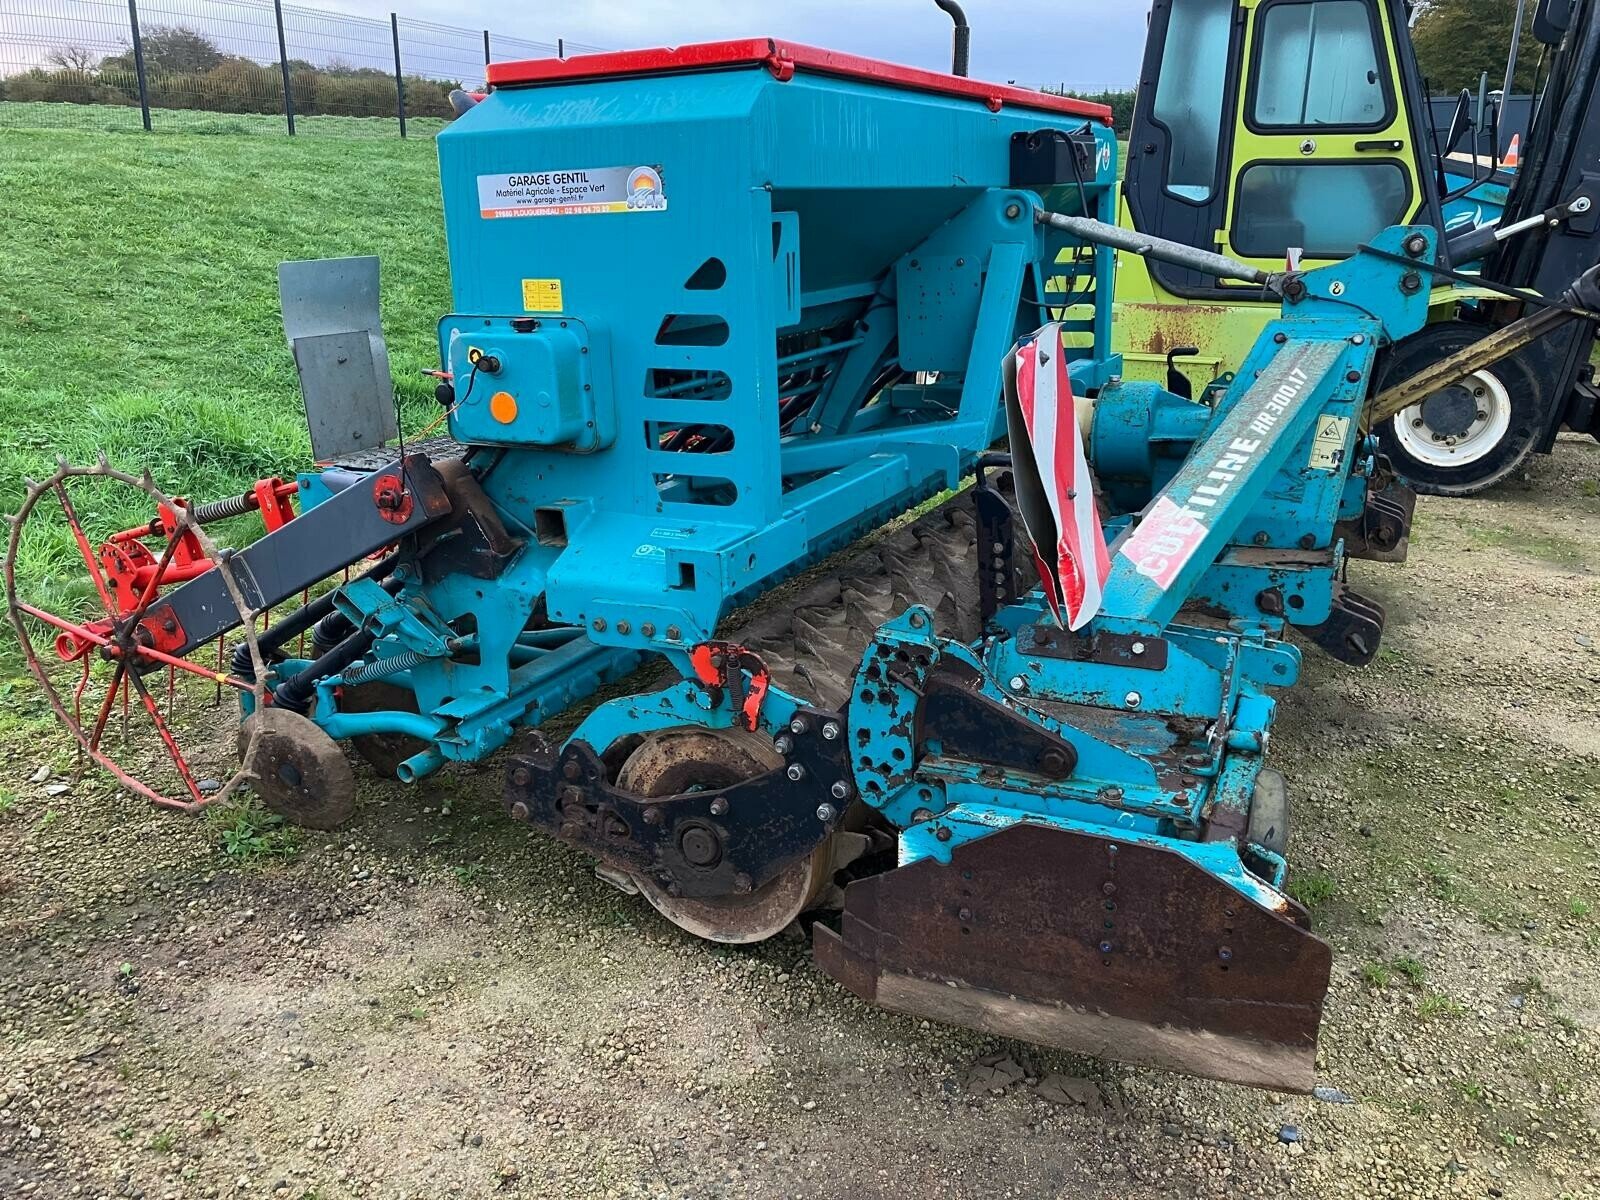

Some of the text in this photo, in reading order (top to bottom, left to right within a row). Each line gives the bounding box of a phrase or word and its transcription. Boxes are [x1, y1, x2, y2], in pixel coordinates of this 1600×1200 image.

[508, 172, 590, 187] GARAGE GENTIL
[495, 188, 524, 198] Matériel
[525, 186, 555, 197] Agricole
[561, 185, 588, 195] Espace
[589, 183, 606, 192] Vert
[516, 194, 585, 205] www.garage-gentil.fr
[626, 193, 665, 209] SCAR
[1135, 437, 1262, 577] CULTILINE
